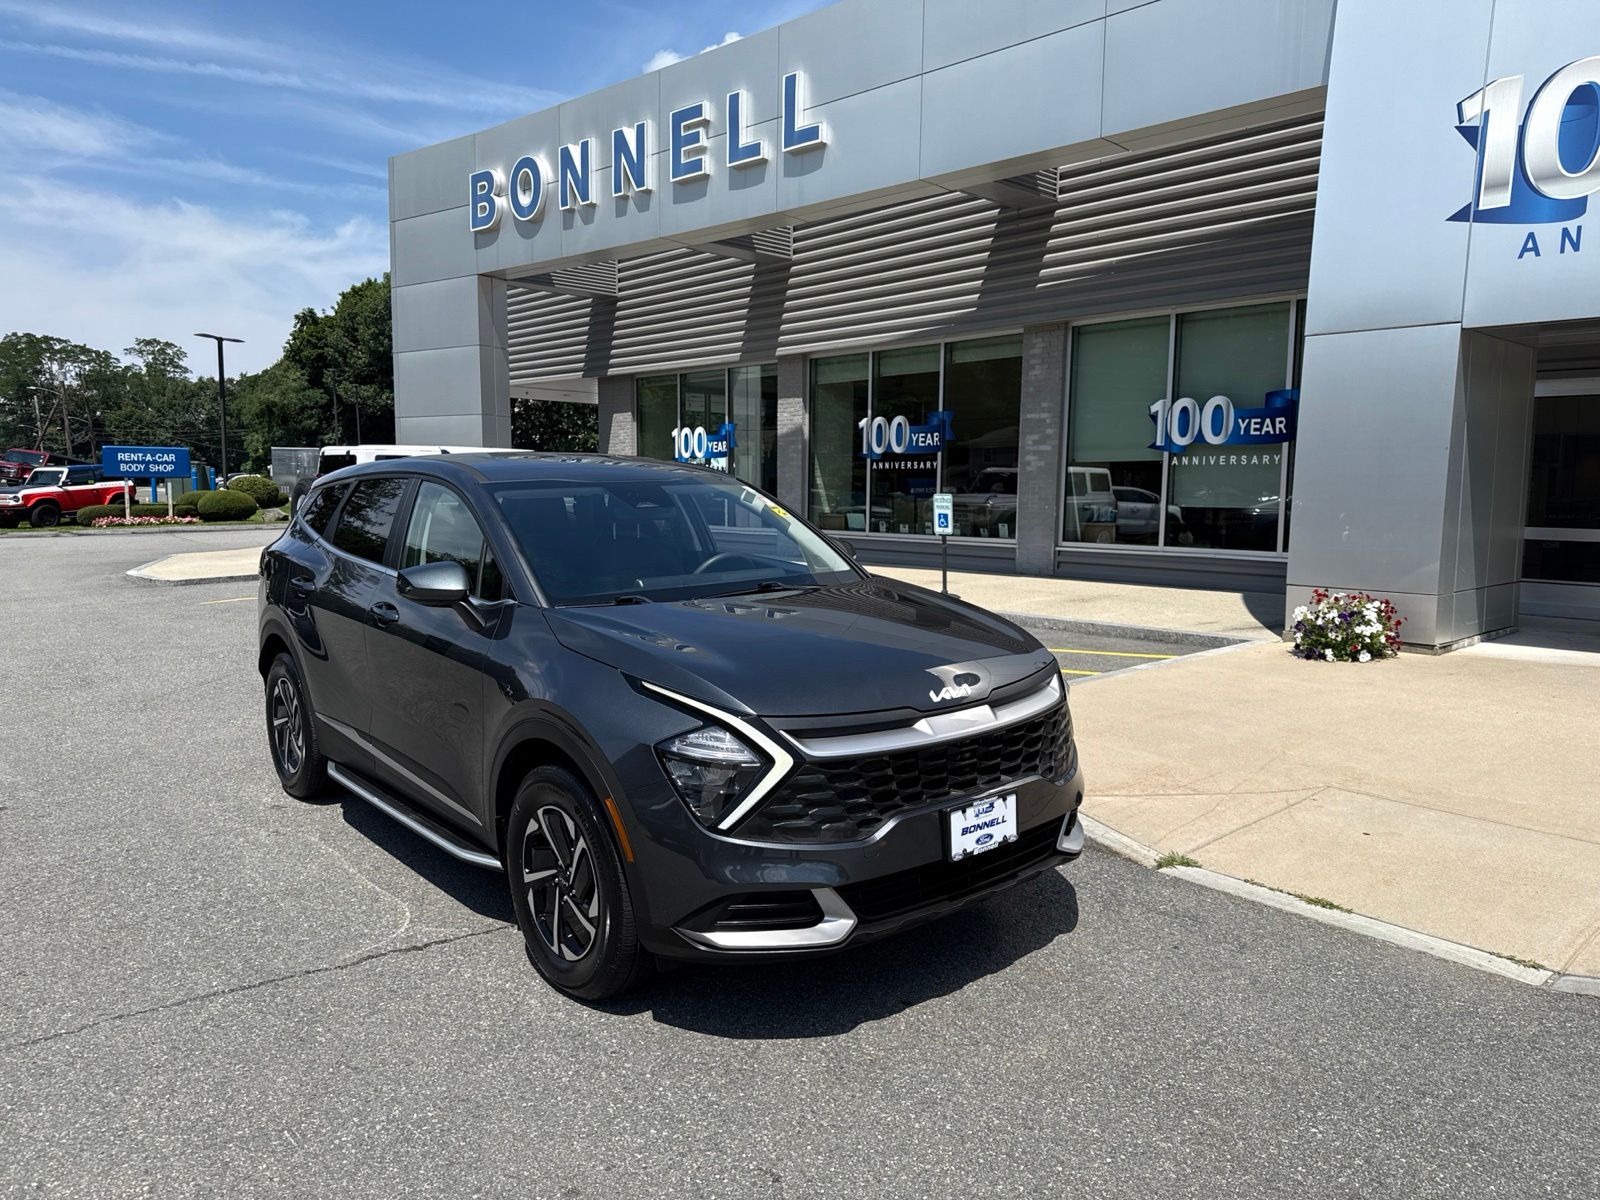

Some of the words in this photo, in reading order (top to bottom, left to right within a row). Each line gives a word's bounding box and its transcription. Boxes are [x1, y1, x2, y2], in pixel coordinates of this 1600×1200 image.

[469, 70, 827, 232] BONNELL
[1517, 225, 1583, 259] AN
[1150, 395, 1235, 447] 100
[1238, 416, 1287, 436] YEAR
[671, 426, 707, 459] 100
[858, 415, 910, 455] 100
[911, 432, 940, 447] YEAR
[117, 452, 176, 462] RENT-A-CAR
[120, 463, 145, 472] BODY
[149, 463, 175, 472] SHOP
[872, 461, 938, 470] ANNIVERSARY
[1171, 454, 1282, 466] ANNIVERSARY
[961, 815, 1007, 836] BONNELL
